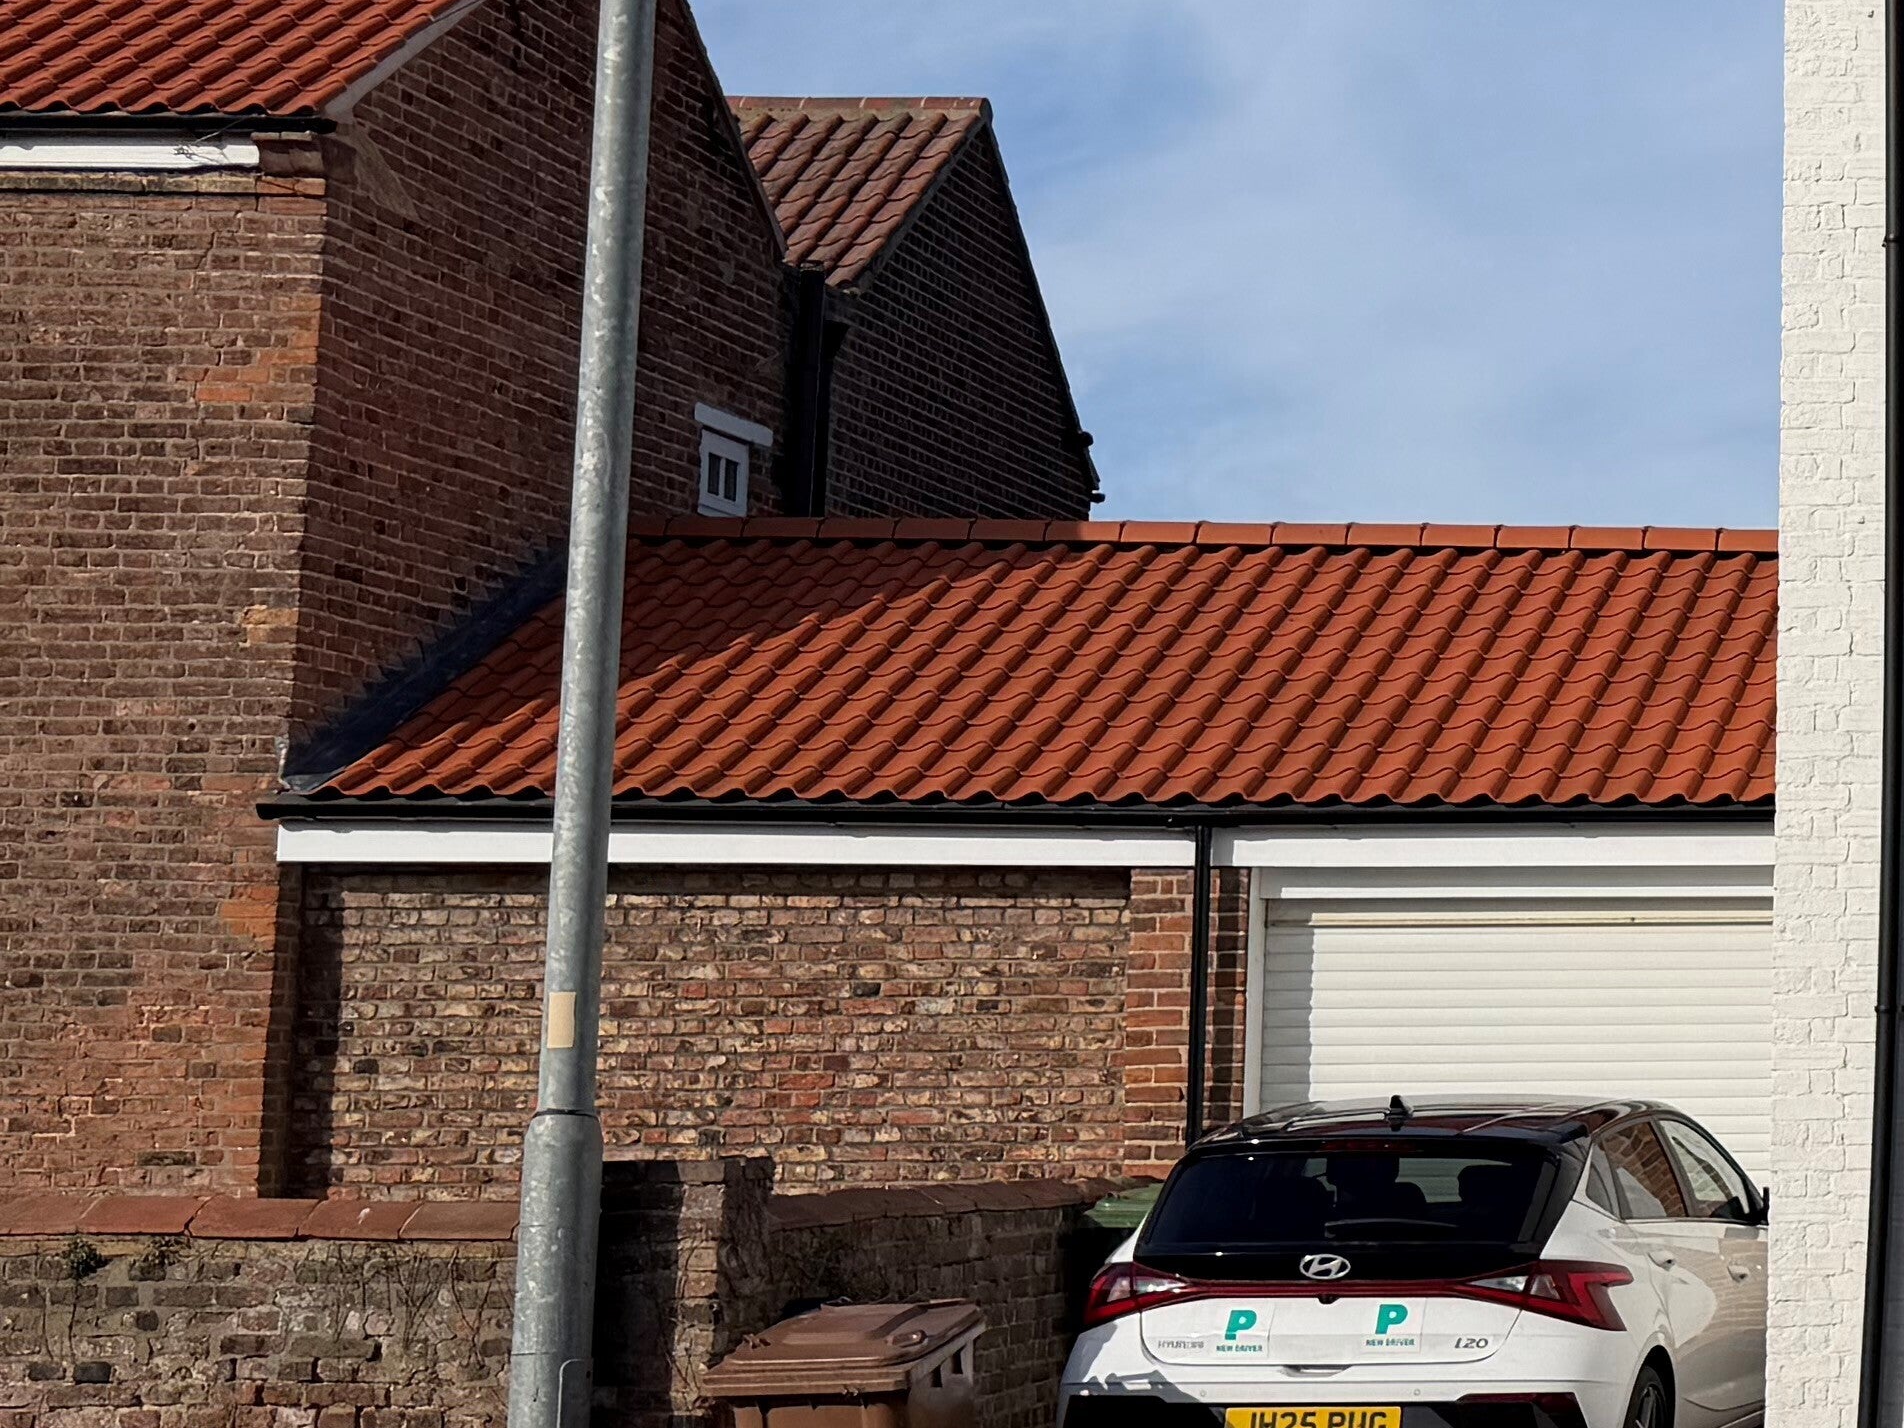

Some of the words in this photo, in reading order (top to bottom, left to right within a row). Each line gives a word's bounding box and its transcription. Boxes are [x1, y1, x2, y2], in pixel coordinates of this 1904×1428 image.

[1375, 1304, 1408, 1334] P
[1225, 1310, 1257, 1340] P
[1158, 1340, 1204, 1349] HYUN
[1366, 1338, 1383, 1346] NEW
[1216, 1344, 1233, 1352] NEW
